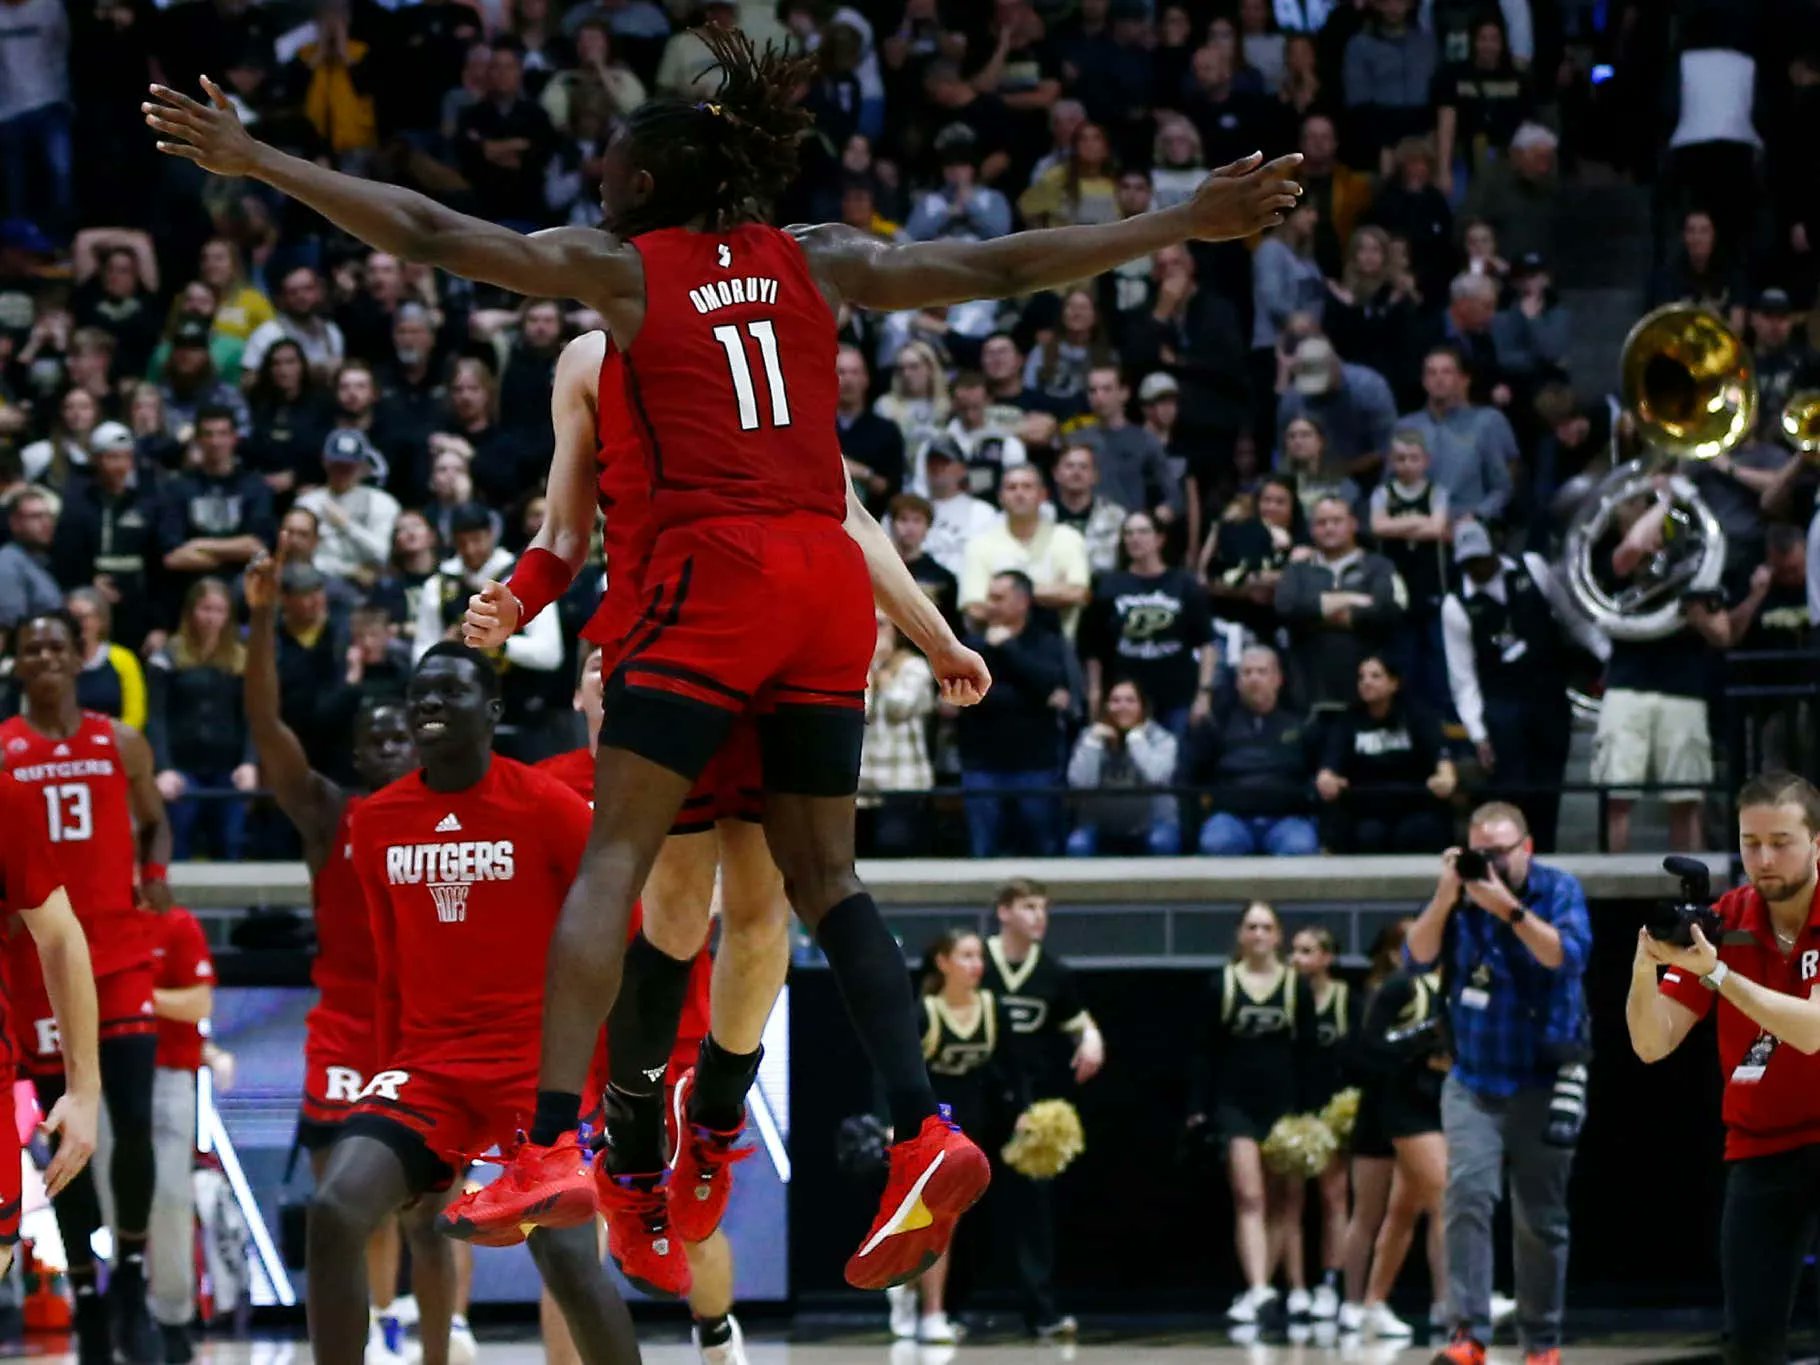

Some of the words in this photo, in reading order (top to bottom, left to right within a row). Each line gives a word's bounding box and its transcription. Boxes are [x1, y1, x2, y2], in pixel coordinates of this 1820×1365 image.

[689, 277, 778, 314] OMORUYI
[713, 320, 790, 430] 11
[13, 759, 113, 781] RUTGERS
[43, 782, 92, 842] 13
[386, 840, 514, 885] RUTGERS
[325, 1065, 362, 1103] R
[358, 1069, 410, 1101] R
